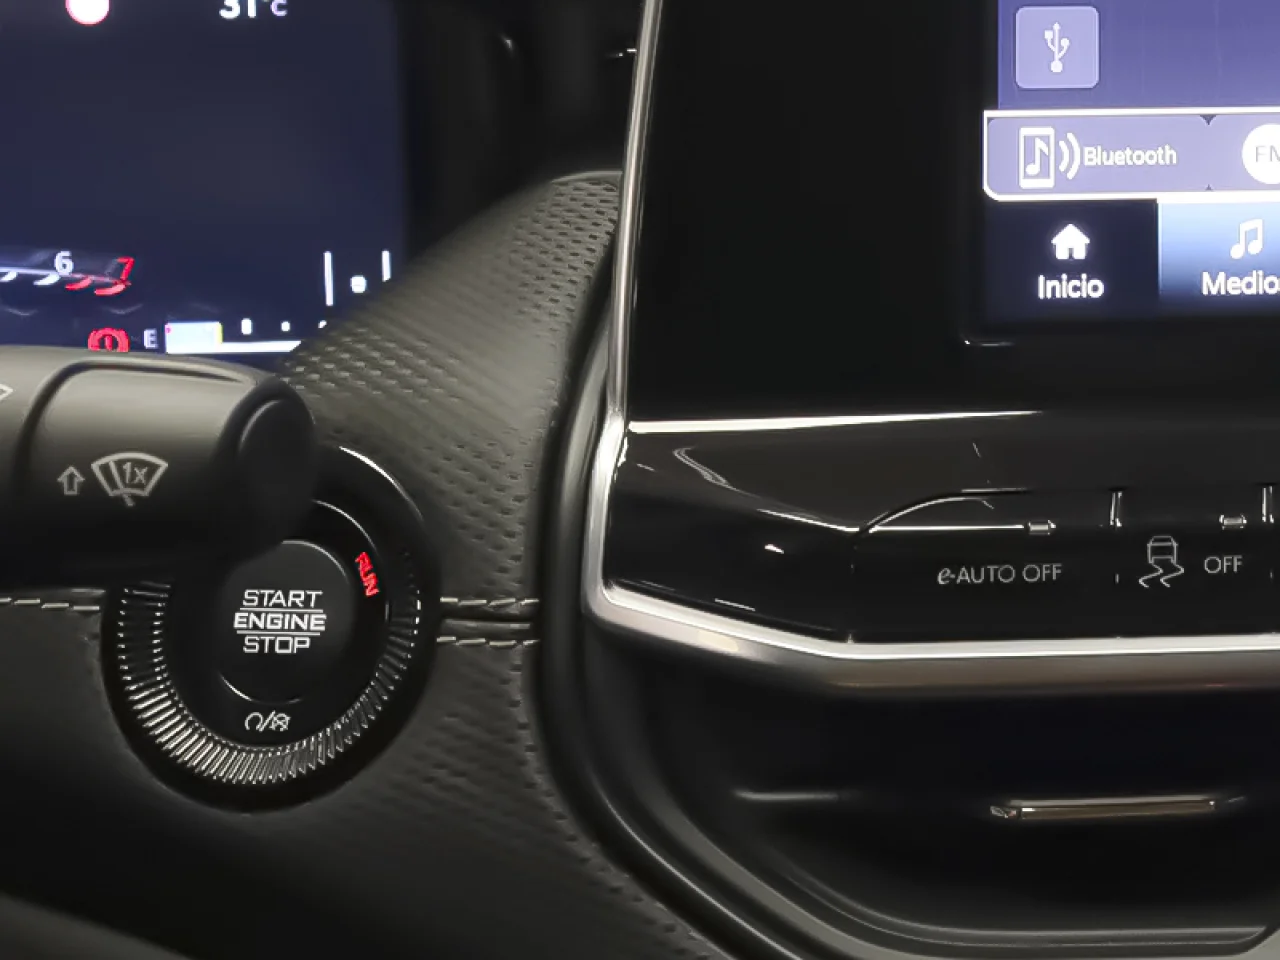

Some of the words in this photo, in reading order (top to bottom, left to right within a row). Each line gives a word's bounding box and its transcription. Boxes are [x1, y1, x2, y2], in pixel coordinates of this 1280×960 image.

[1083, 146, 1177, 167] Bluetooth
[54, 250, 74, 276] 6
[117, 256, 135, 284] 7
[1037, 274, 1105, 300] Inicio
[143, 328, 158, 349] E
[354, 551, 380, 597] RUN
[1022, 564, 1063, 582] OFF
[1204, 556, 1243, 574] OFF
[242, 589, 323, 608] START
[233, 613, 327, 631] ENGINE
[243, 636, 311, 654] STOP
